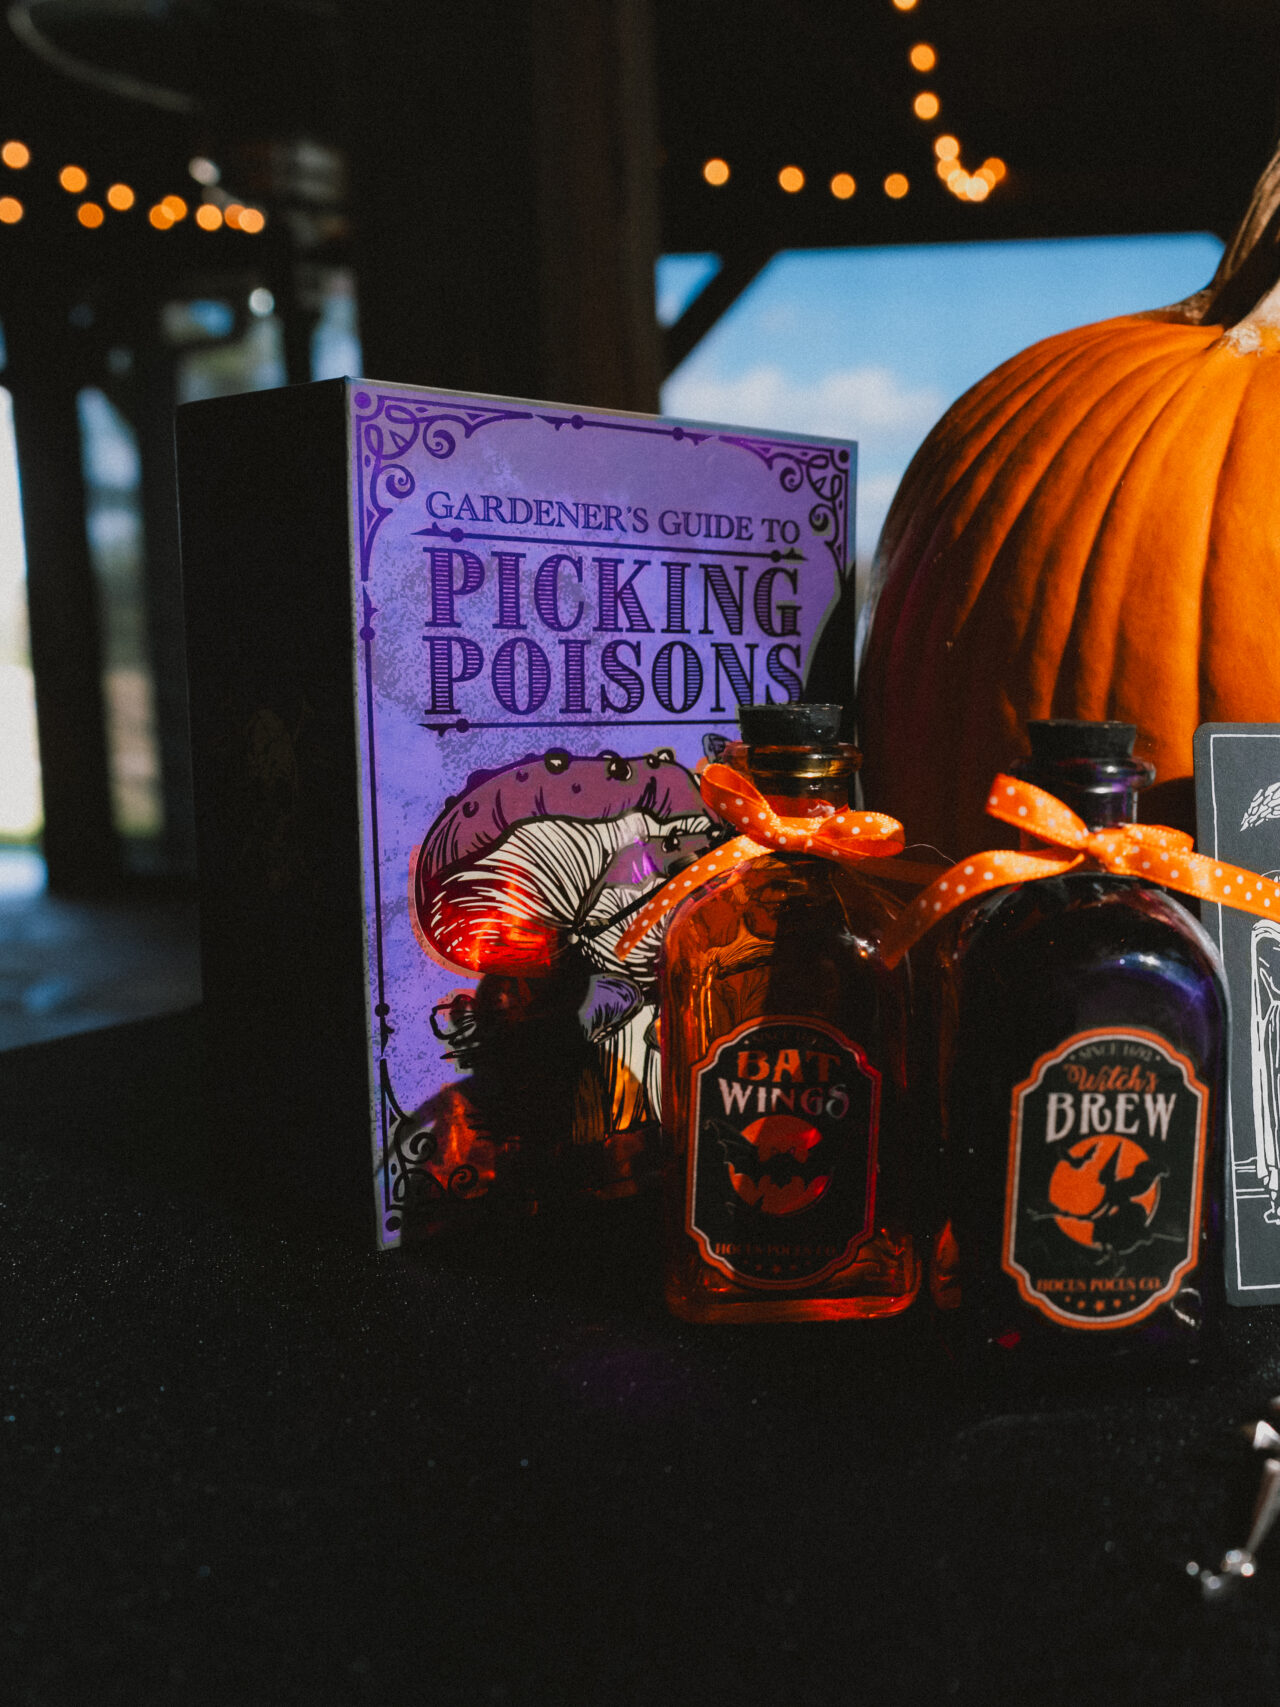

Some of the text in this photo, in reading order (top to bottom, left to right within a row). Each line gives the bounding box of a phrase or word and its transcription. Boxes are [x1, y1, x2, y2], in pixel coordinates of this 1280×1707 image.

[425, 490, 801, 545] GARDENER'S GUIDE TO
[422, 546, 804, 638] PICKING
[421, 635, 804, 715] POISONS
[736, 1048, 841, 1083] BAT
[1063, 1064, 1157, 1093] Witch's
[717, 1077, 850, 1119] WINGS
[1045, 1092, 1177, 1143] BREW
[1036, 1278, 1087, 1292] HOCUS
[1089, 1277, 1136, 1291] POCUS
